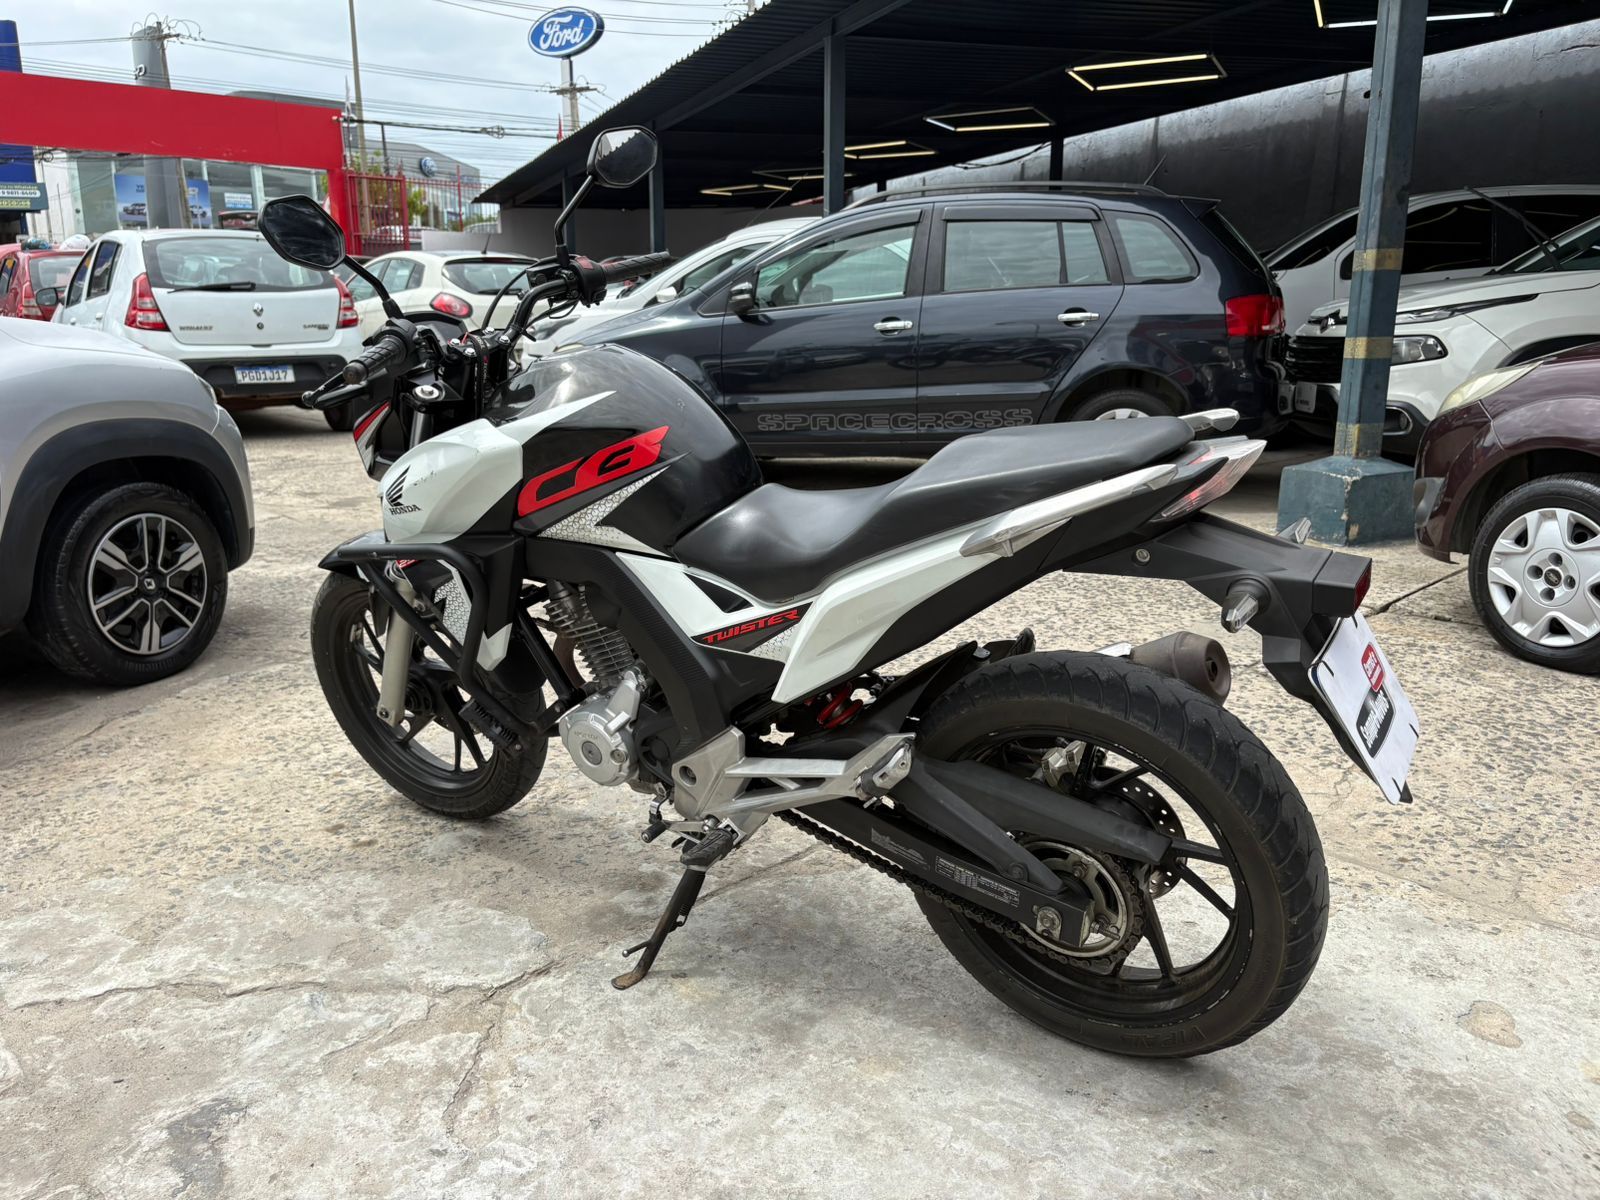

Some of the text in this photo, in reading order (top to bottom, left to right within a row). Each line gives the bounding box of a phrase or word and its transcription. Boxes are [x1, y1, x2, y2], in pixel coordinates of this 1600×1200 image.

[540, 14, 585, 50] Ford
[241, 370, 288, 383] PGD1J17
[758, 408, 1033, 432] SPACECROSS
[518, 425, 671, 517] CB
[389, 504, 421, 516] HONDA
[702, 609, 801, 644] TWISTER
